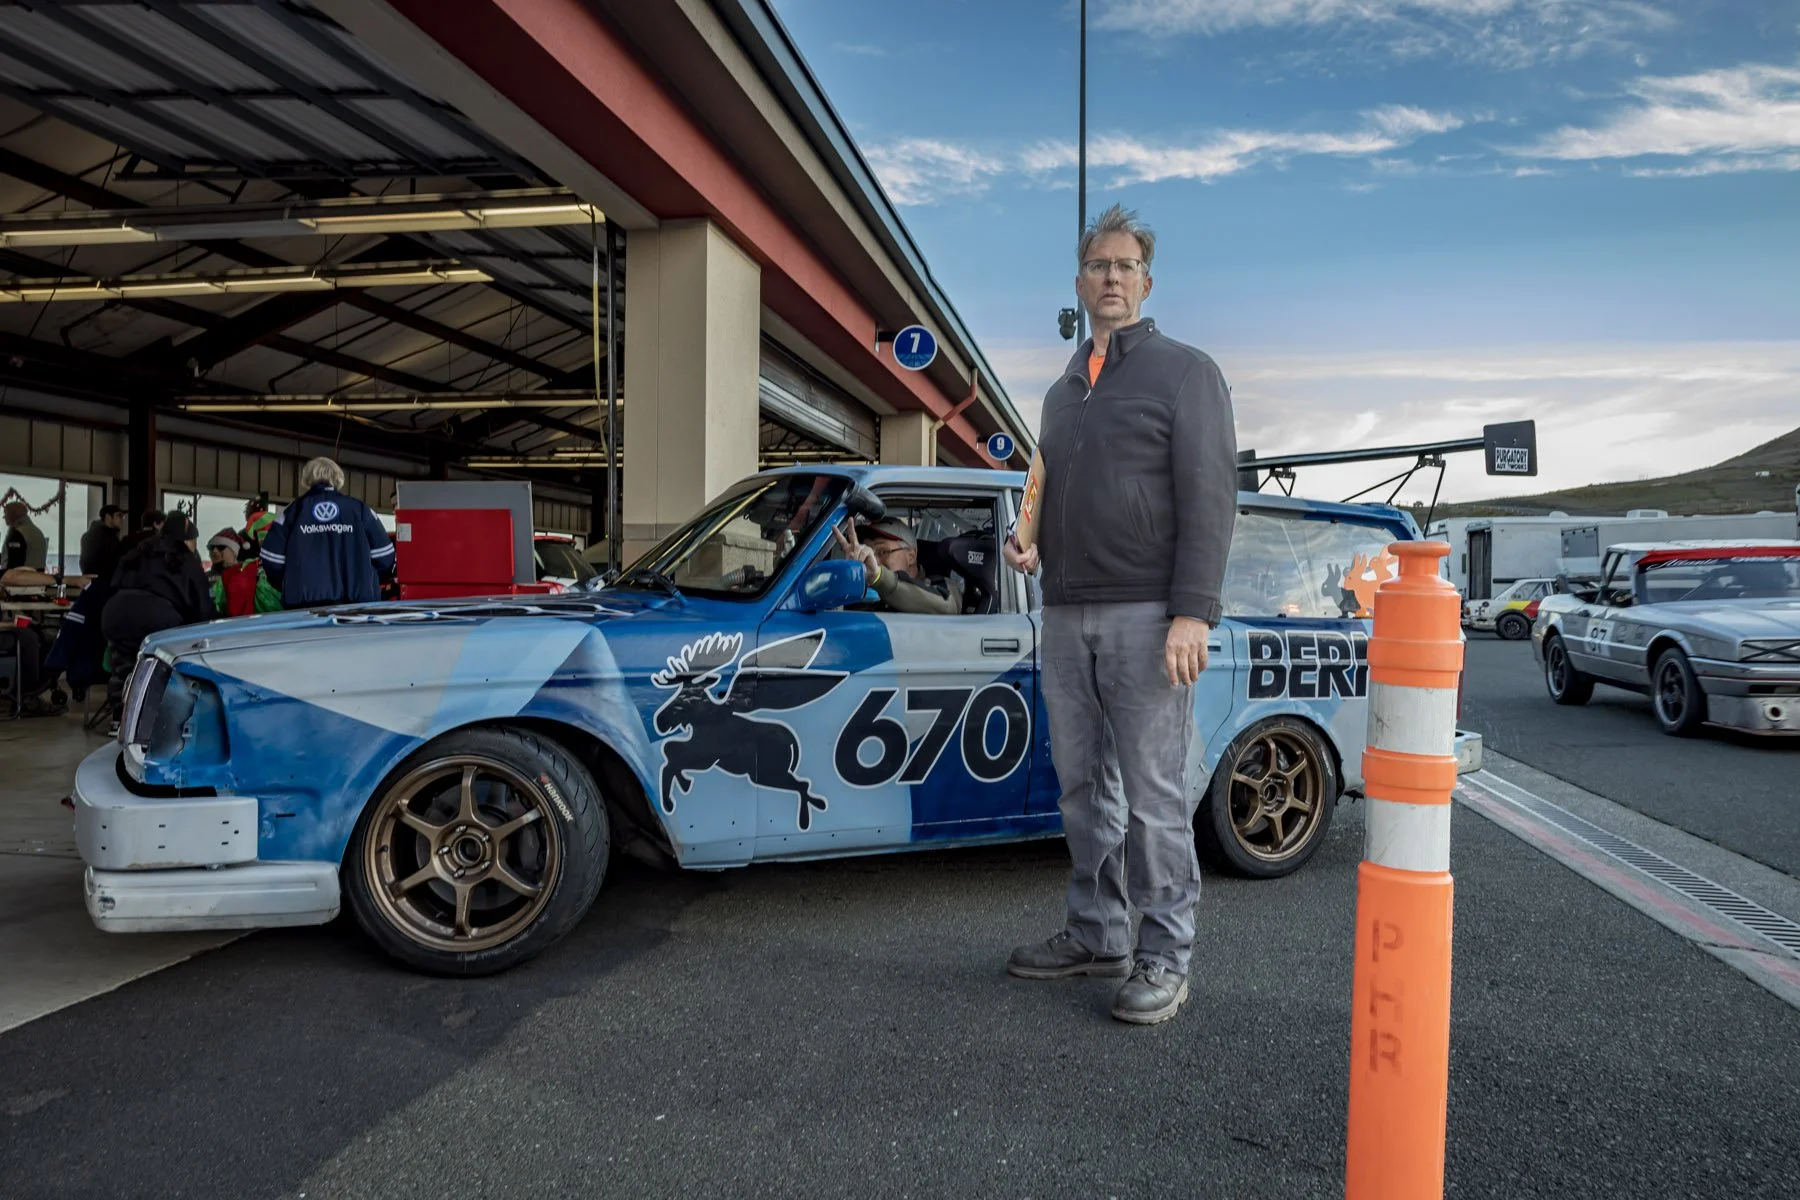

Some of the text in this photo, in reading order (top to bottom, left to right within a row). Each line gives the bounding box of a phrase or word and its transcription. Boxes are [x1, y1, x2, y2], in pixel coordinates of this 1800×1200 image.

[910, 332, 921, 353] 7
[996, 436, 1005, 450] 9
[1496, 449, 1527, 464] PURGATORY
[300, 524, 353, 534] Volkswagen
[833, 682, 1031, 789] 670
[544, 783, 574, 822] Hankook
